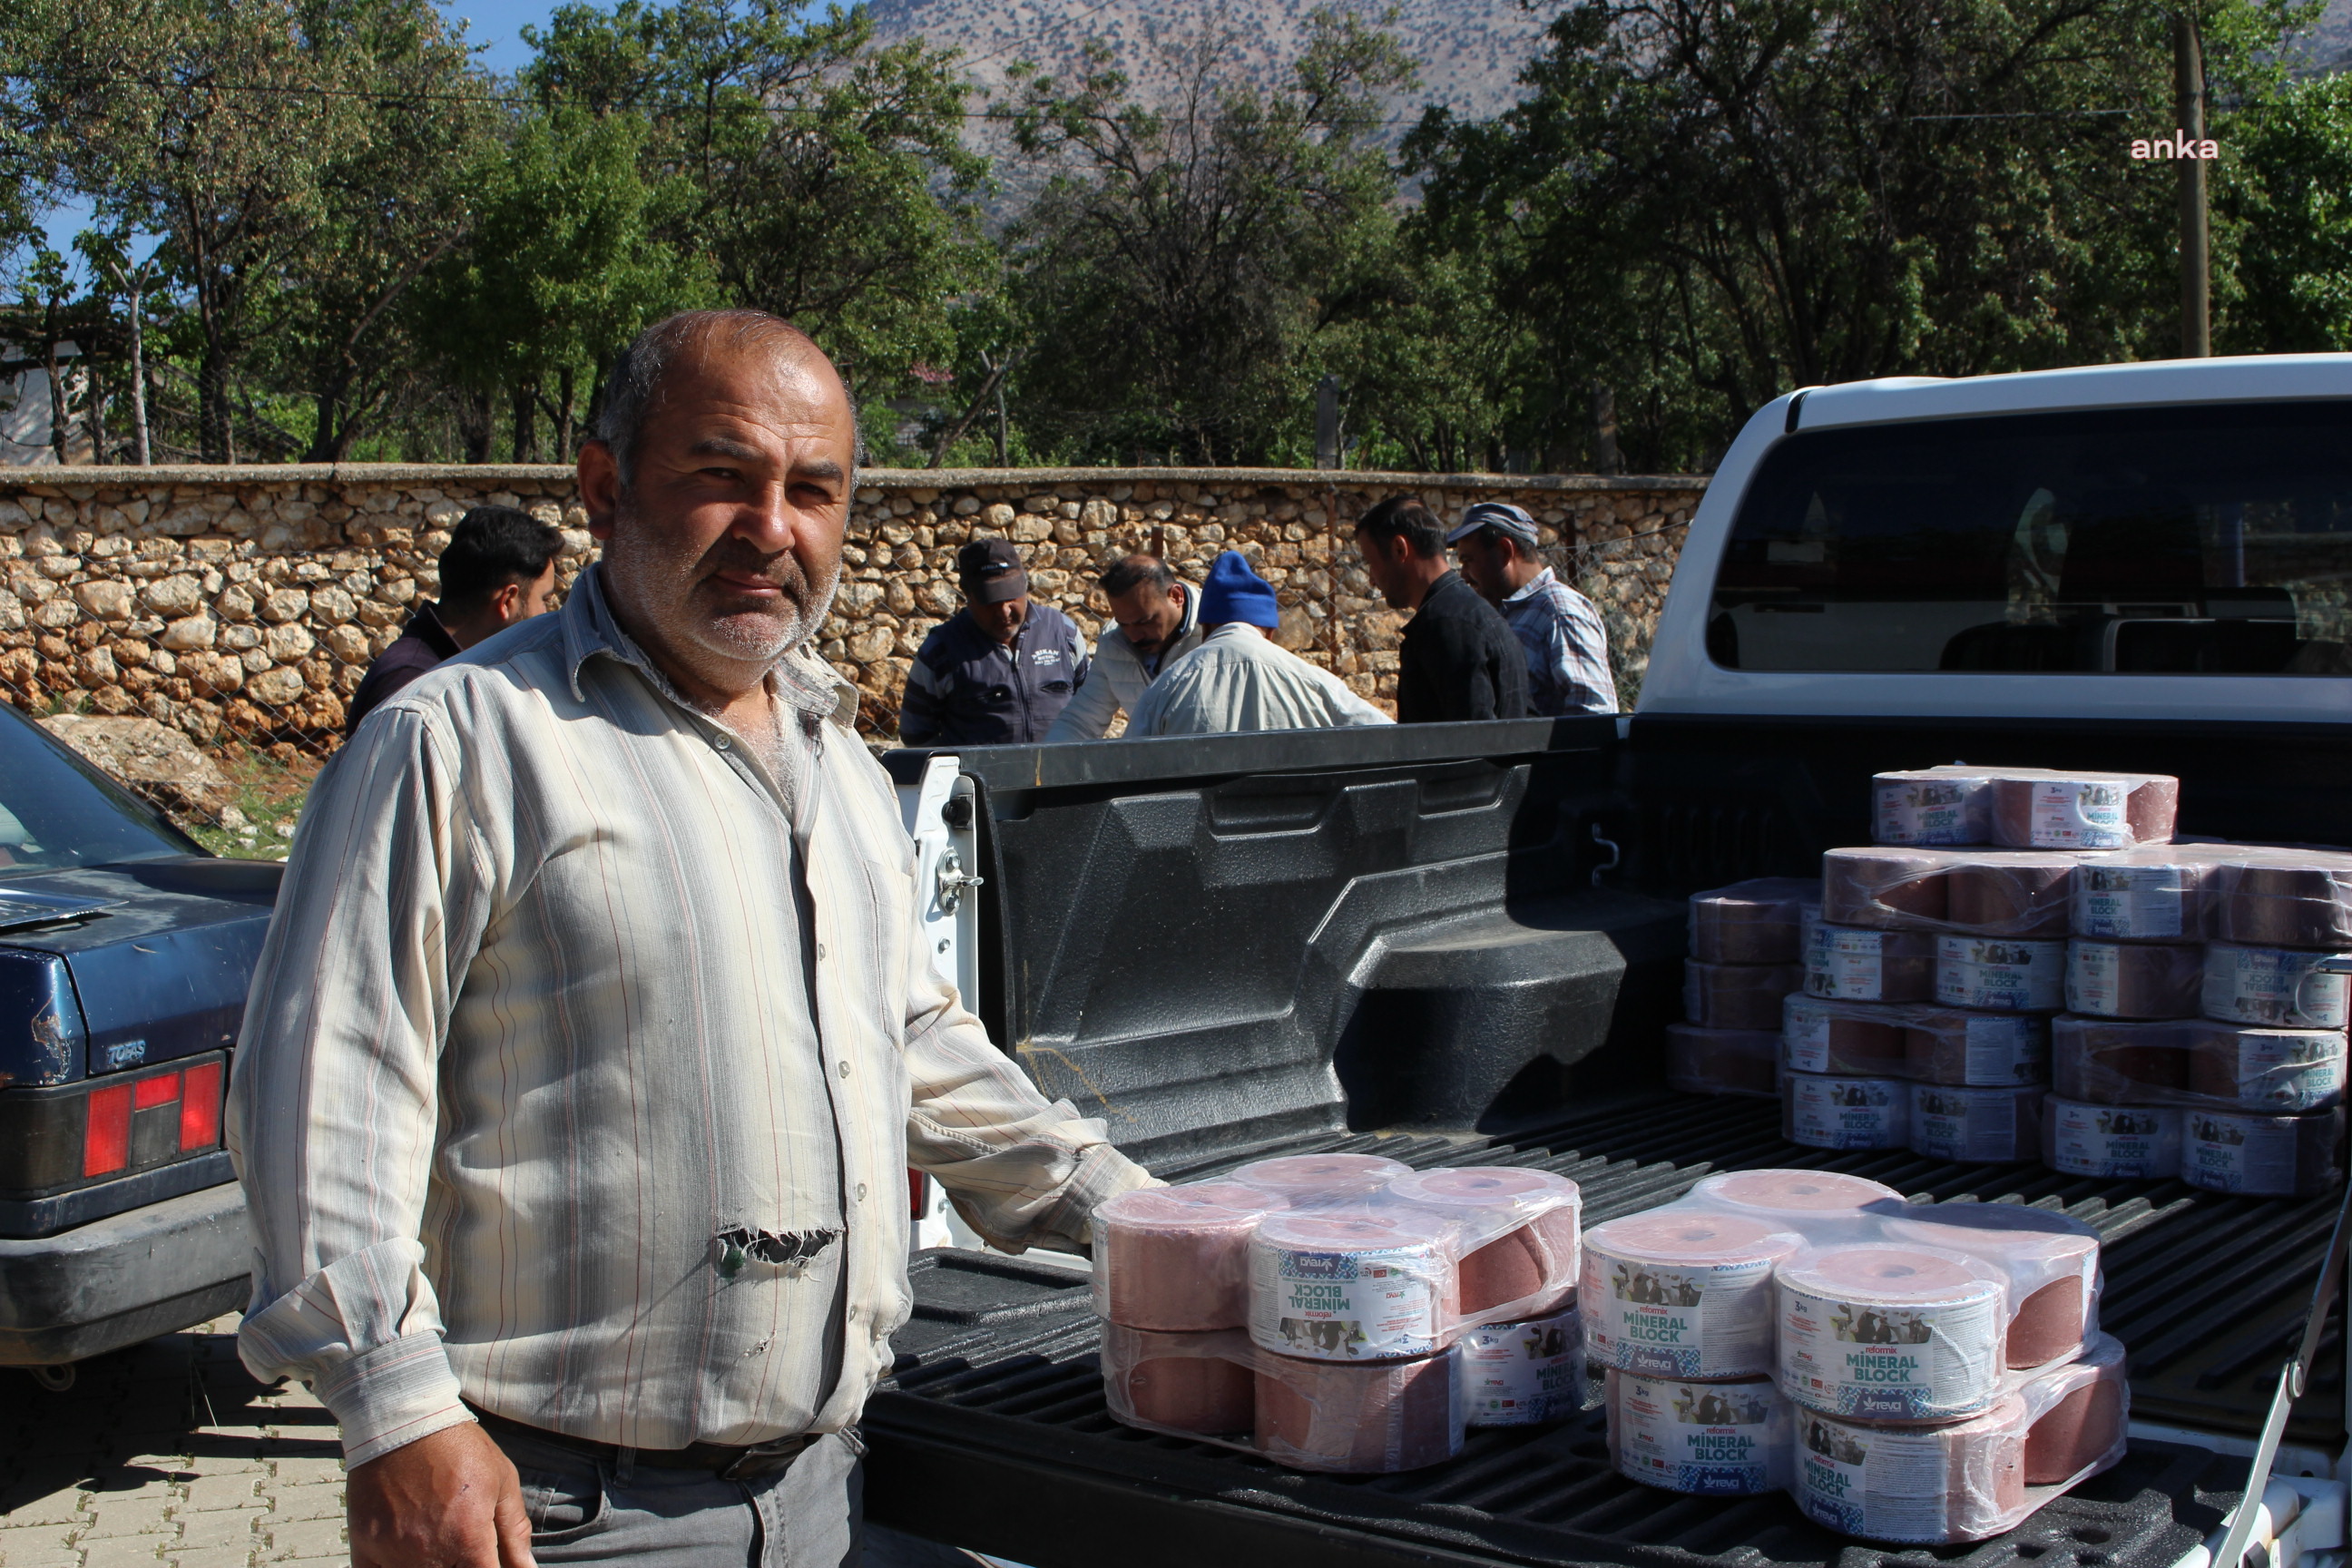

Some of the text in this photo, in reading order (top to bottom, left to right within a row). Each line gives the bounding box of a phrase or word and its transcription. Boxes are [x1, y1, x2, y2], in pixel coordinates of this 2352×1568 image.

[1294, 1284, 1342, 1298] BLOCK
[1639, 1305, 1668, 1315] reformix
[1795, 1300, 1808, 1313] 3kg
[1305, 1310, 1332, 1318] reformix
[1483, 1336, 1499, 1345] 3kg
[1630, 1325, 1681, 1343] BLOCK
[1865, 1346, 1897, 1355] reformix
[1648, 1357, 1671, 1370] reva
[1854, 1367, 1911, 1383] BLOCK
[1543, 1374, 1576, 1390] BLOCK
[1876, 1400, 1902, 1410] reva
[1706, 1426, 1736, 1435] reformix
[1694, 1448, 1748, 1461] BLOCK
[1715, 1478, 1740, 1488] reva
[1807, 1474, 1845, 1499] BLOCK
